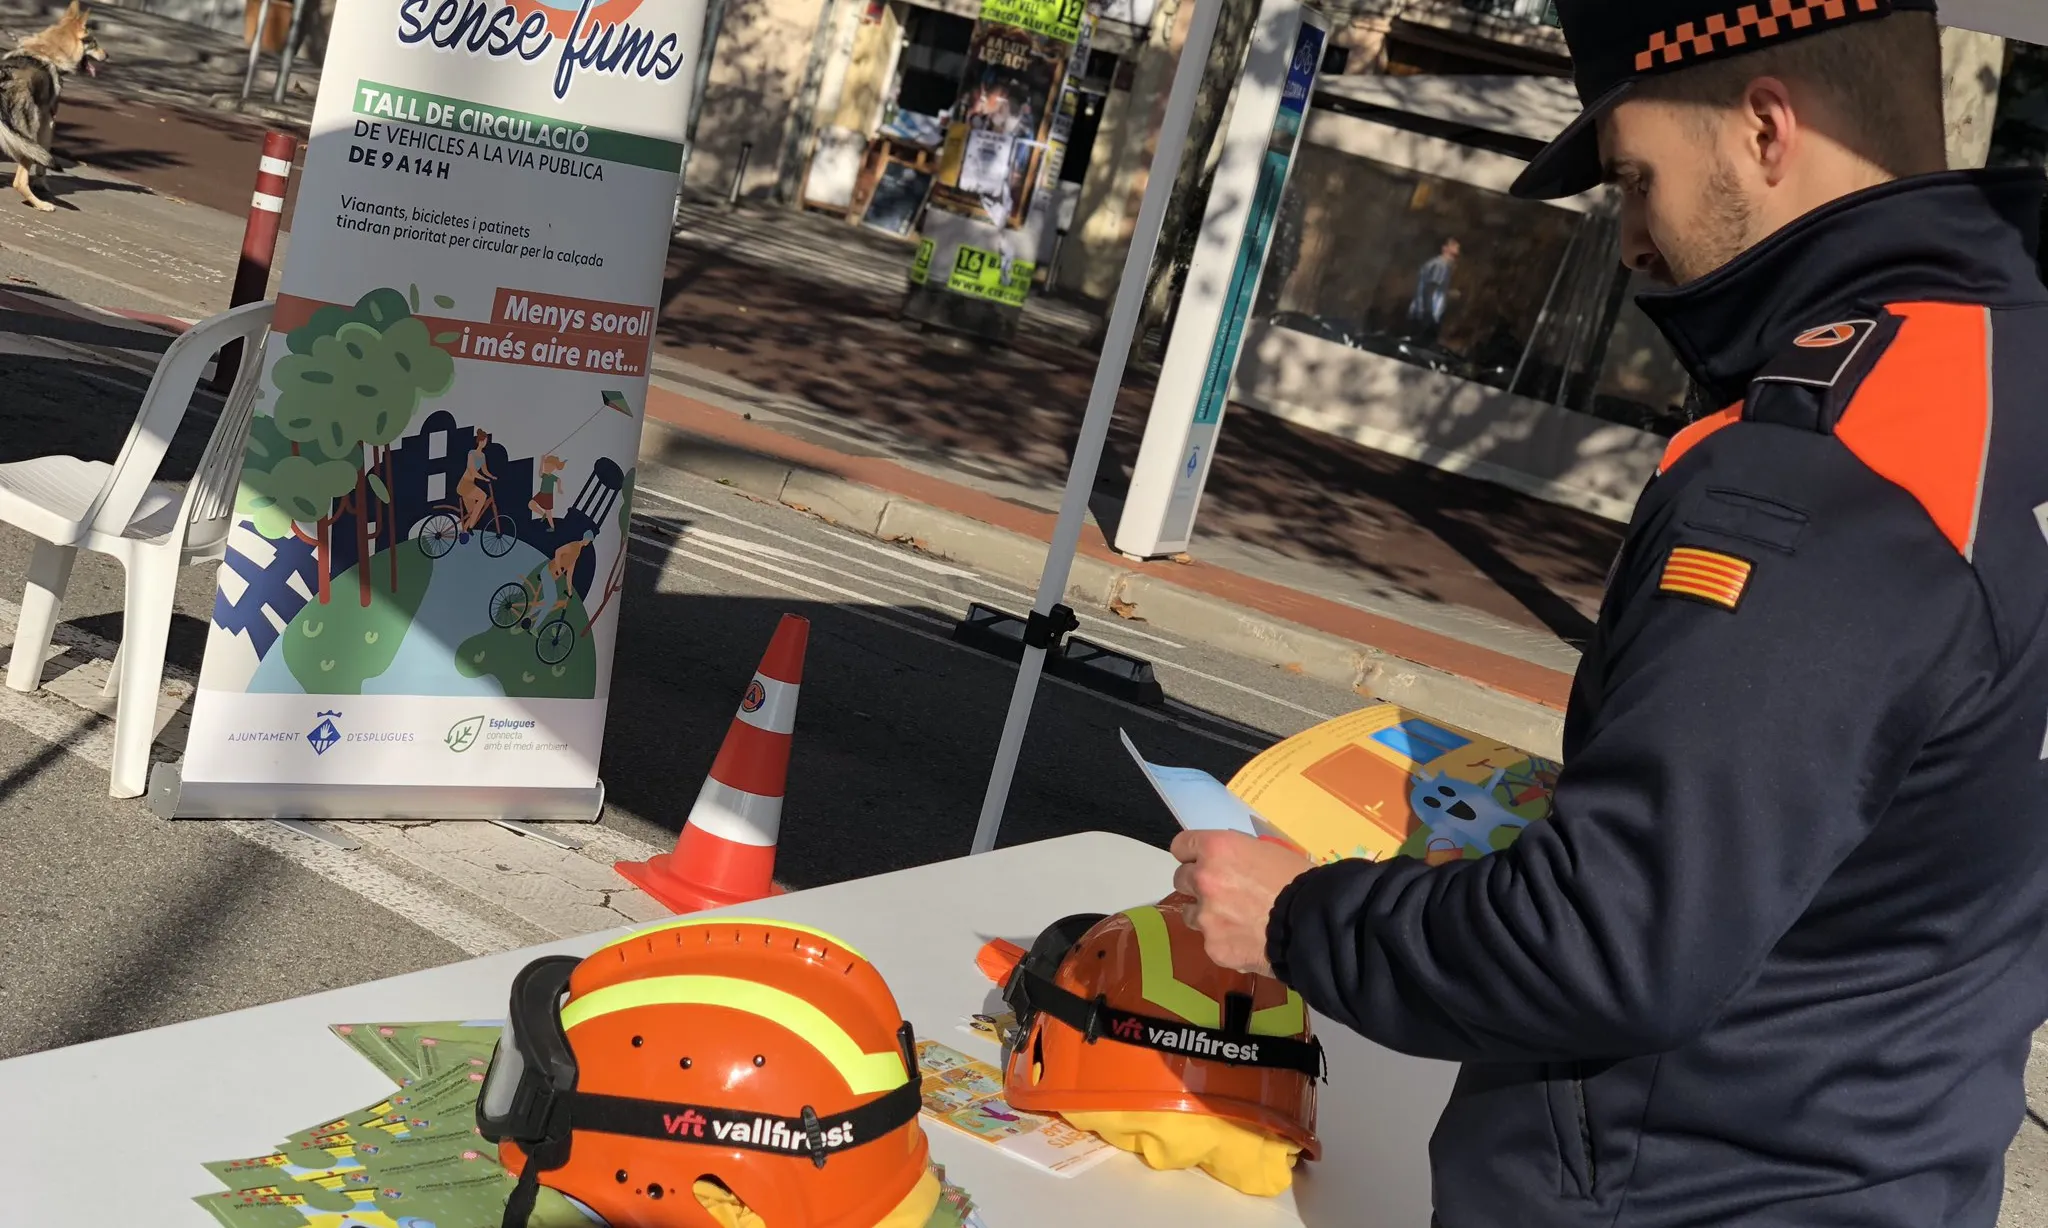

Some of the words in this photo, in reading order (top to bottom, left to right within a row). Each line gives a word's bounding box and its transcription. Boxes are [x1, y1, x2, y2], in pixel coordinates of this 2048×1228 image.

[398, 0, 552, 60] sense
[553, 0, 683, 99] fums
[361, 88, 420, 122] TALL
[425, 101, 455, 128] DE
[459, 108, 589, 153] CIRCULACIÓ
[348, 145, 378, 167] DE
[381, 152, 394, 169] 9
[396, 155, 410, 173] A
[414, 158, 433, 177] 14
[437, 162, 450, 180] H
[354, 119, 381, 140] DE
[387, 125, 465, 156] VEHICLES
[467, 141, 479, 160] A
[483, 143, 502, 164] LA
[507, 147, 534, 169] VIA
[539, 154, 603, 181] PUBLICA
[340, 194, 408, 221] Vianants,
[412, 207, 469, 229] bicicletes
[472, 216, 477, 230] i
[478, 218, 530, 238] patinets
[336, 214, 390, 236] tindran
[393, 224, 447, 244] prioritat
[449, 234, 470, 248] per
[472, 236, 518, 255] circular
[520, 245, 540, 259] per
[542, 246, 554, 260] la
[556, 249, 604, 267] calçada
[503, 295, 586, 333] Menys
[590, 310, 651, 337] soroll
[460, 326, 470, 353] i
[474, 332, 526, 360] més
[531, 337, 581, 366] aire
[585, 348, 638, 373] net...
[228, 731, 301, 742] AJUNTAMENT
[346, 732, 415, 743] D'ESPLUGUES
[486, 731, 523, 741] connecta
[489, 718, 536, 730] Esplugues
[484, 741, 501, 751] amb
[503, 741, 512, 751] el
[514, 741, 534, 751] medi
[536, 742, 568, 751] ambient
[1112, 1017, 1145, 1040] vft
[1149, 1027, 1259, 1061] vallfirest
[662, 1109, 707, 1137] vft
